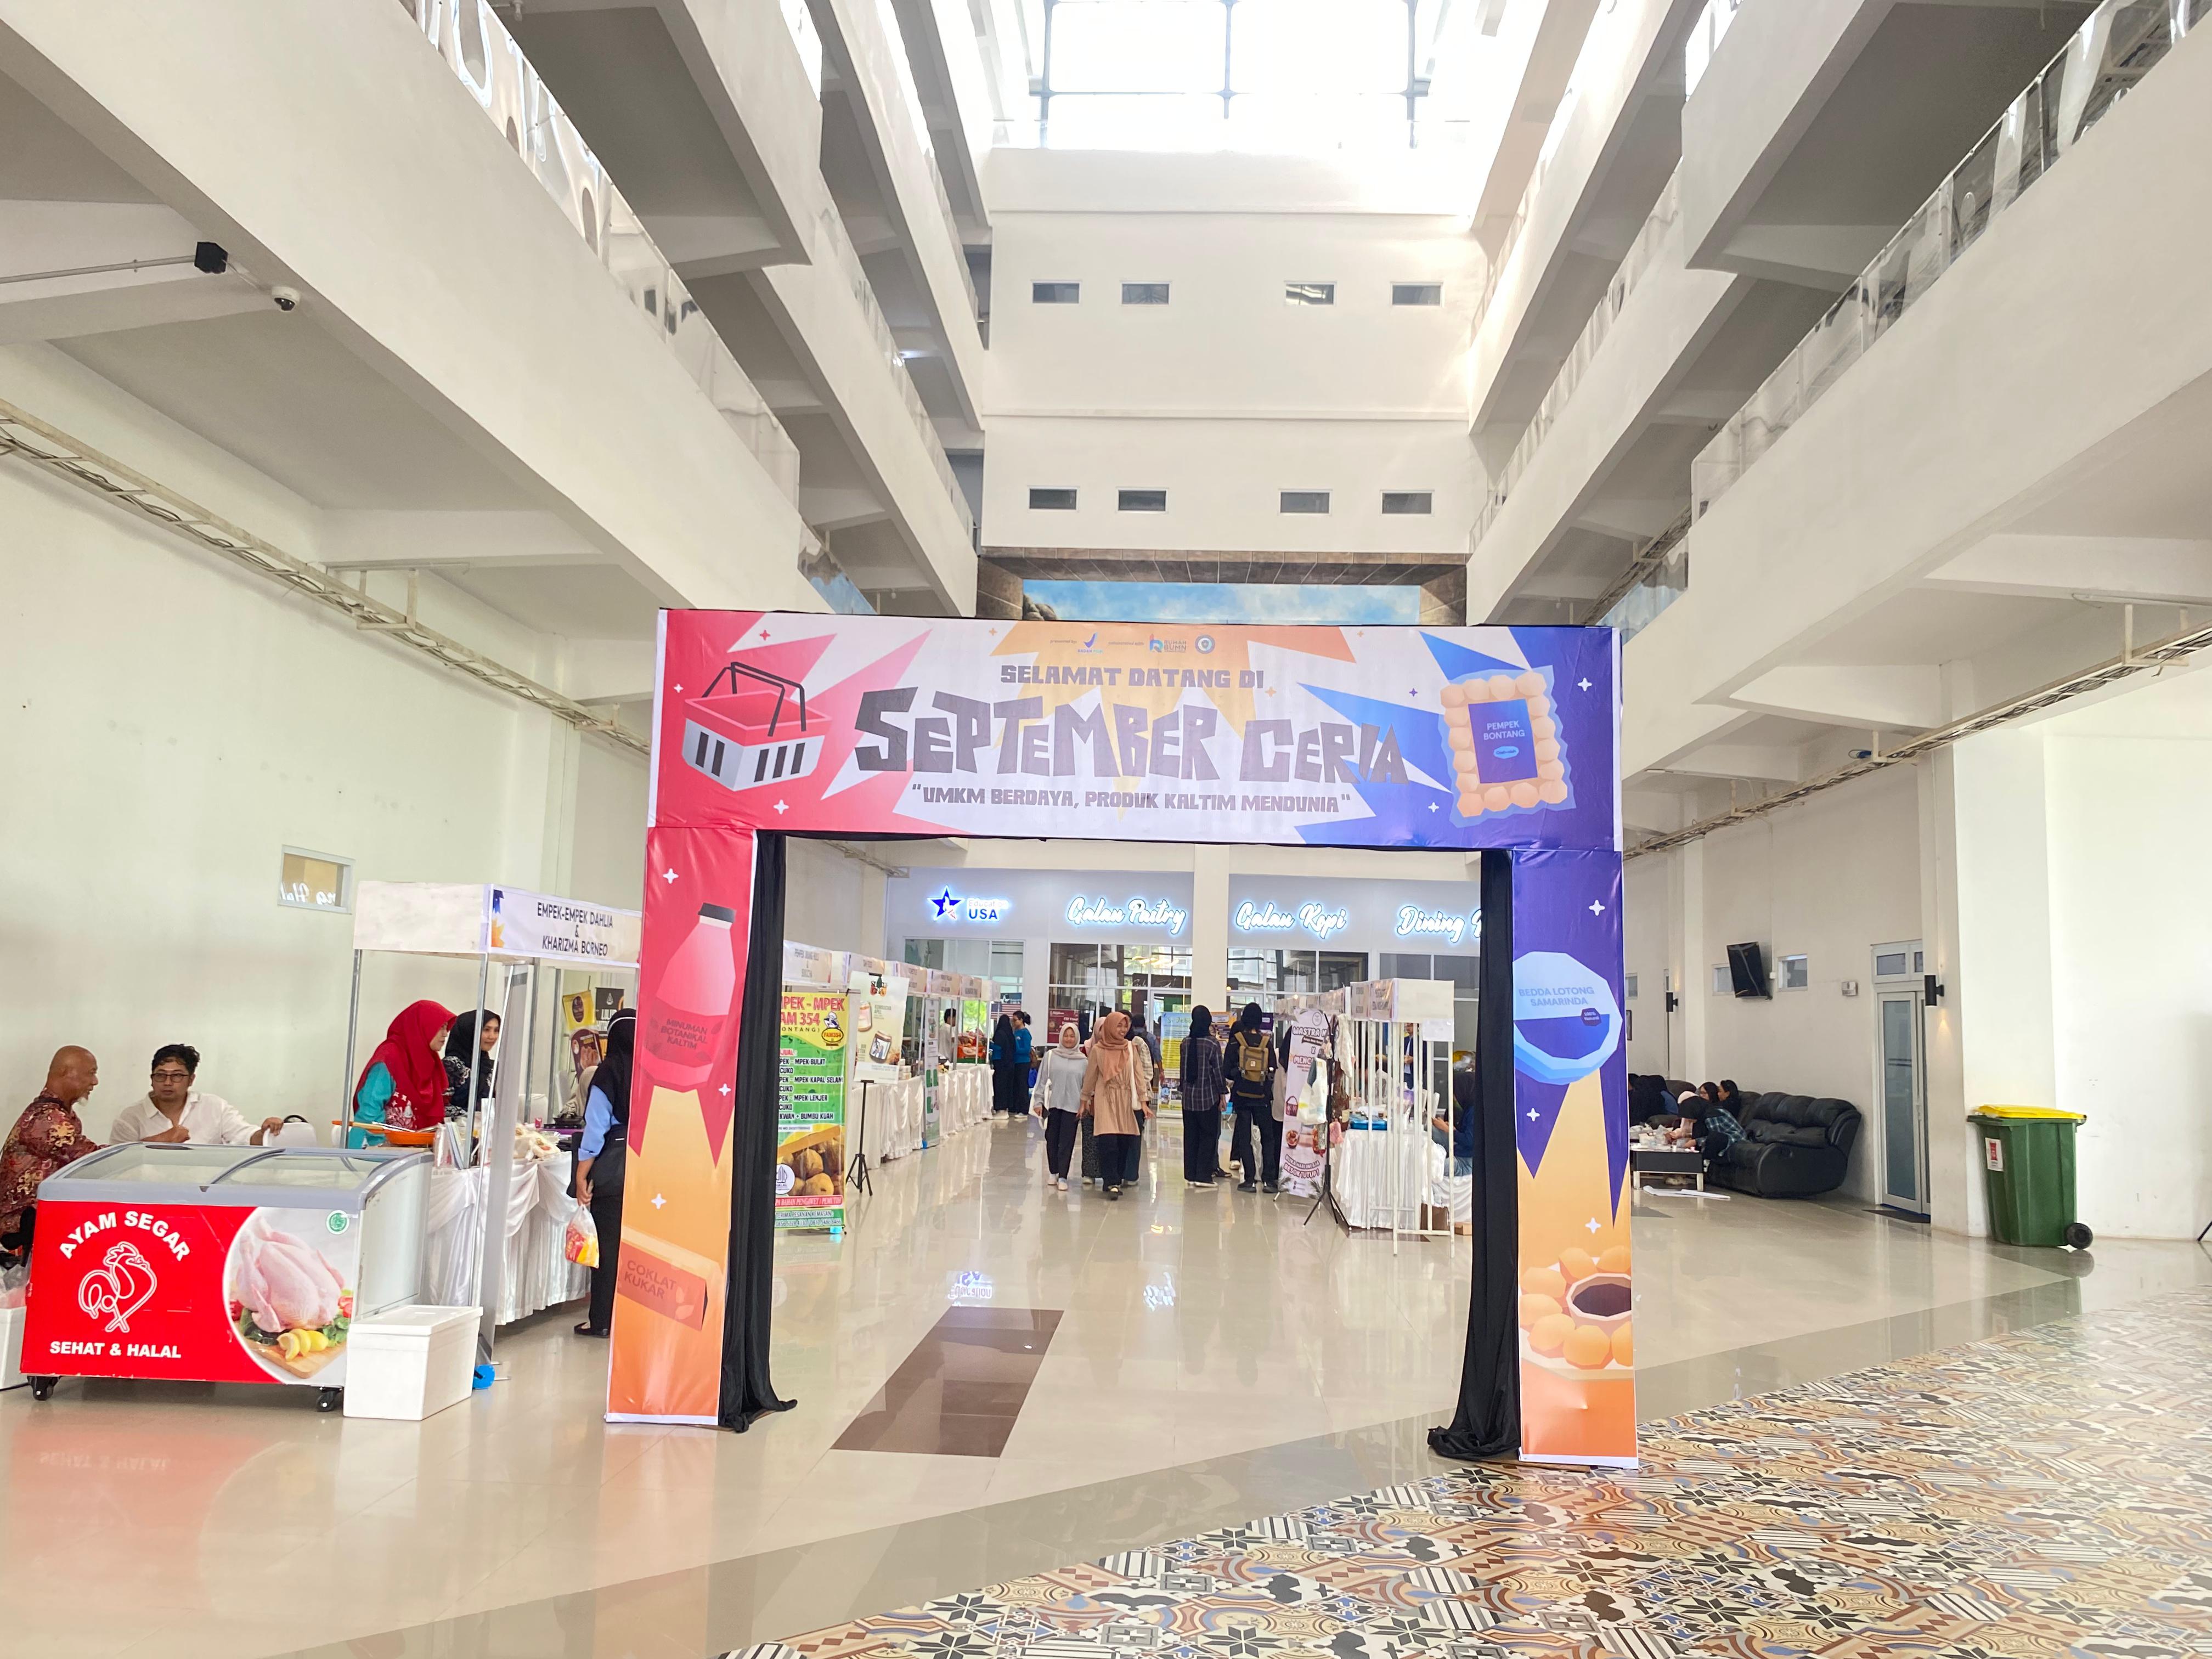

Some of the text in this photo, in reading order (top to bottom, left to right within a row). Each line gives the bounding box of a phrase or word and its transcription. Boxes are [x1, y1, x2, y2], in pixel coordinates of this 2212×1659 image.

[1000, 663, 1265, 690] SELAMAT DATANG DI
[1486, 720, 1520, 731] PEMPEK
[855, 686, 1409, 785] SEPTEMBER CERIA
[1483, 729, 1526, 741] BONTANG
[991, 788, 1080, 810] BERDAYA,
[1085, 791, 1161, 809] PRODUK
[1165, 793, 1237, 812] KALTIM
[968, 899, 1008, 907] Educato
[537, 902, 613, 928] EMPEK-EMPEK DAHLIA
[968, 909, 998, 919] USA
[1127, 899, 1186, 934] Pastry
[1299, 903, 1347, 939] Kopi
[574, 924, 579, 938] &
[1397, 906, 1465, 943] Dining
[541, 935, 608, 957] KHARIZMA BORNEO
[1518, 986, 1595, 997] BEDDA LOTONG
[813, 997, 845, 1011] MPEK
[1530, 996, 1589, 1006] SAMARINDA
[666, 1018, 708, 1035] MINUMAN
[799, 1012, 820, 1026] 354
[660, 1025, 707, 1043] BOTANIKAL
[1293, 1026, 1321, 1037] WASTRA
[667, 1035, 698, 1049] KALTIM
[1293, 1055, 1313, 1065] MENC
[1284, 1163, 1300, 1178] BESOK
[59, 1210, 191, 1262] AYAM SEGAR
[627, 1260, 677, 1291] COKLAT
[624, 1271, 665, 1300] KUKAR
[50, 1340, 182, 1359] SEHAT & HALAL
